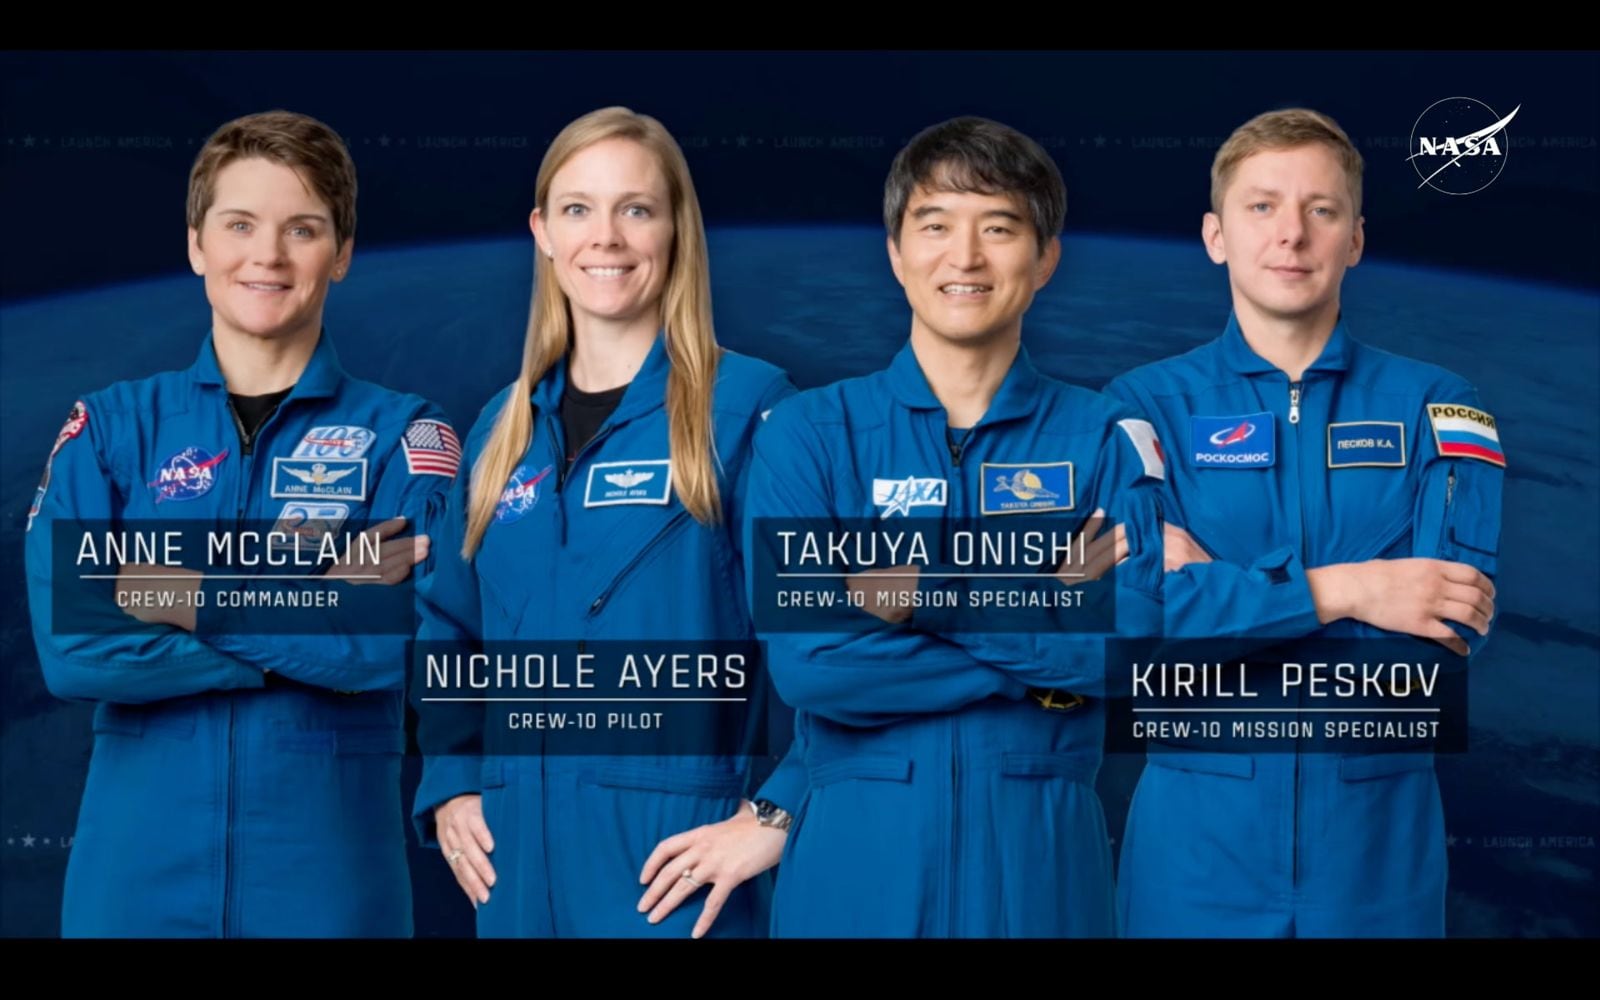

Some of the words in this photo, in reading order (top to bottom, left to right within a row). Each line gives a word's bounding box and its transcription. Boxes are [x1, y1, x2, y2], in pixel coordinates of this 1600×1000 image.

[1432, 407, 1495, 429] РОССИЯ
[1337, 438, 1374, 450] ПЕСКОВ
[1377, 438, 1395, 448] К.А.
[1195, 452, 1270, 463] РОСКОСМОС
[160, 467, 213, 483] NASA
